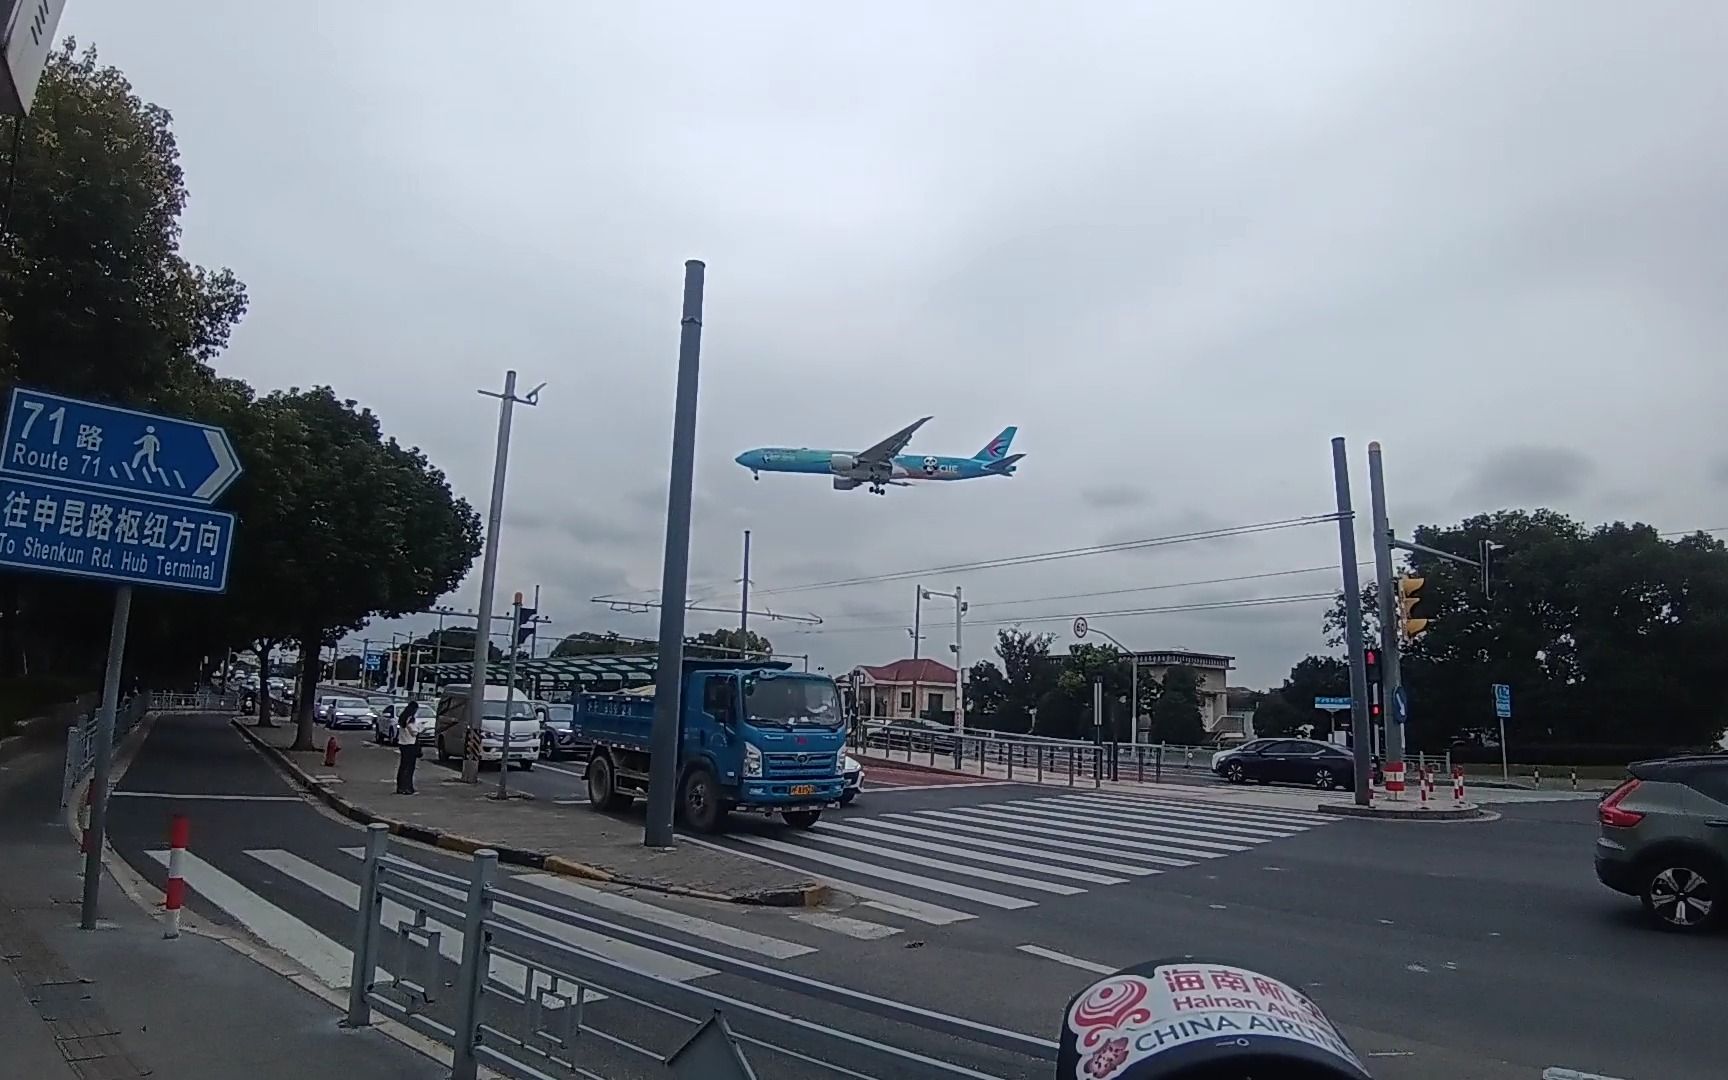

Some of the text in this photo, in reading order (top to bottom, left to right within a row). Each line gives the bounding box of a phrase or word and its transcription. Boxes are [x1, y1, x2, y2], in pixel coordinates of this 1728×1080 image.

[12, 443, 101, 477] Route 71
[3, 491, 221, 556] 往申昆路枢纽方向
[0, 533, 215, 580] To Shenkun Rd. Hub Terminal
[1173, 995, 1261, 1011] Hainan
[1135, 1015, 1241, 1052] CHINA
